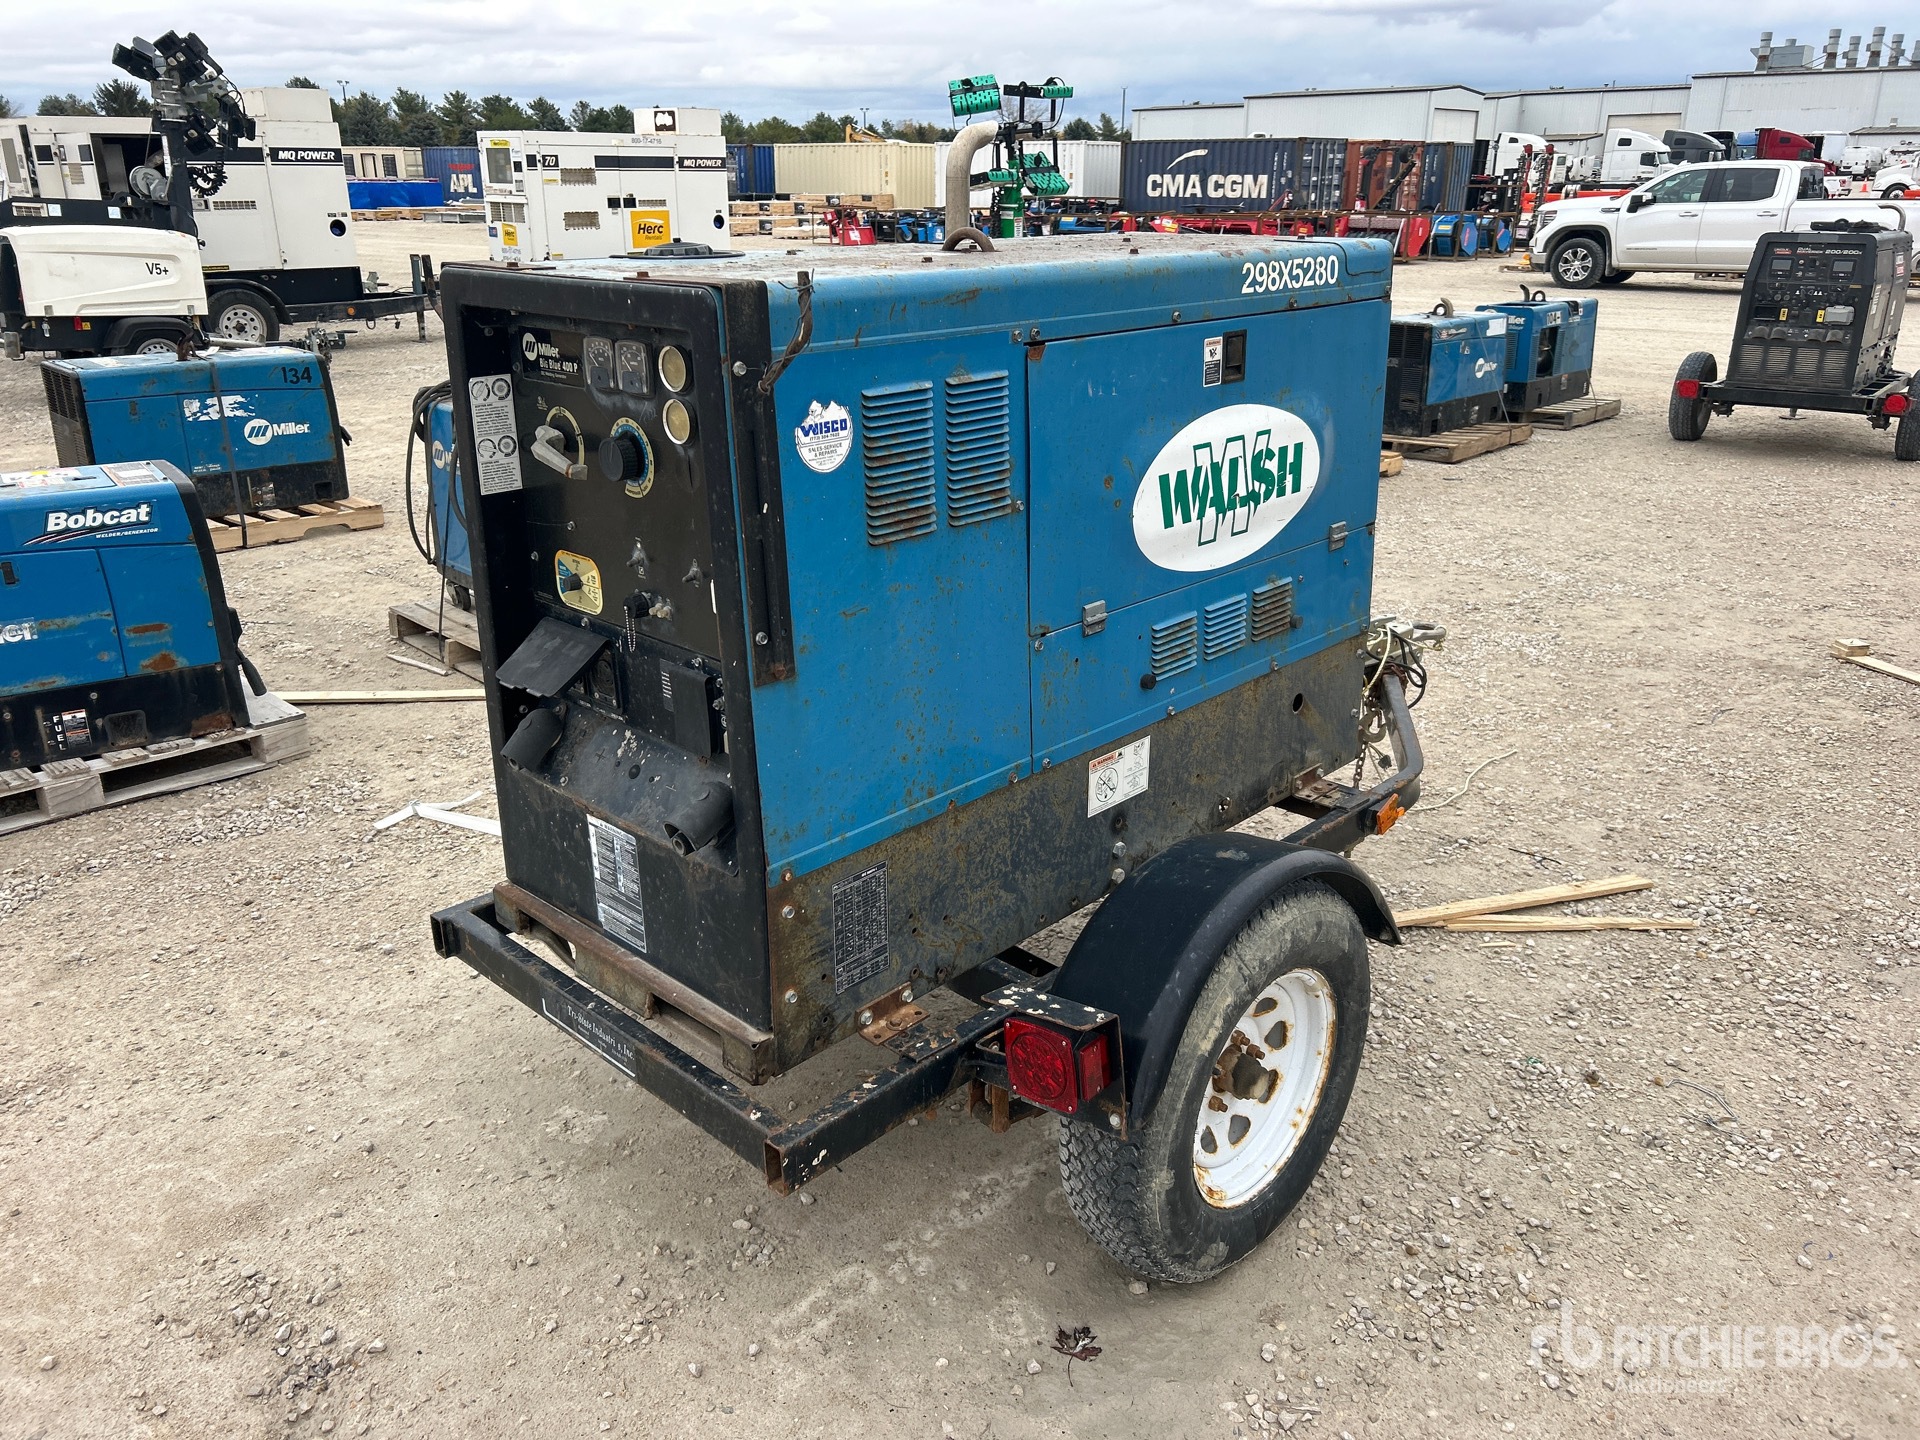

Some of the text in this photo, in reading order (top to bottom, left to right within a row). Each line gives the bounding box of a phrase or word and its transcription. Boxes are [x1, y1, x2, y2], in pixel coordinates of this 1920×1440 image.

[278, 150, 335, 161] MQ POWER
[545, 156, 556, 166] 70
[683, 159, 696, 167] MQ
[450, 173, 478, 193] APL
[1146, 174, 1203, 198] CMA
[1207, 174, 1269, 199] CGM
[637, 223, 664, 235] Herc
[145, 262, 169, 275] V5+
[1241, 254, 1339, 294] 298X5280
[1508, 315, 1526, 325] iller
[538, 342, 559, 358] Miller
[549, 359, 561, 371] Blue
[562, 361, 574, 373] 400
[573, 362, 579, 374] P
[281, 366, 313, 384] 134
[272, 422, 311, 436] Miller
[800, 418, 848, 438] WISCO
[818, 449, 838, 458] REPAIRS
[1158, 441, 1304, 530] WALSH
[46, 503, 151, 532] Bobcat
[95, 527, 159, 539] WELDER/GENERATOR
[52, 715, 67, 751] FUEL
[592, 1022, 624, 1054] Industris,
